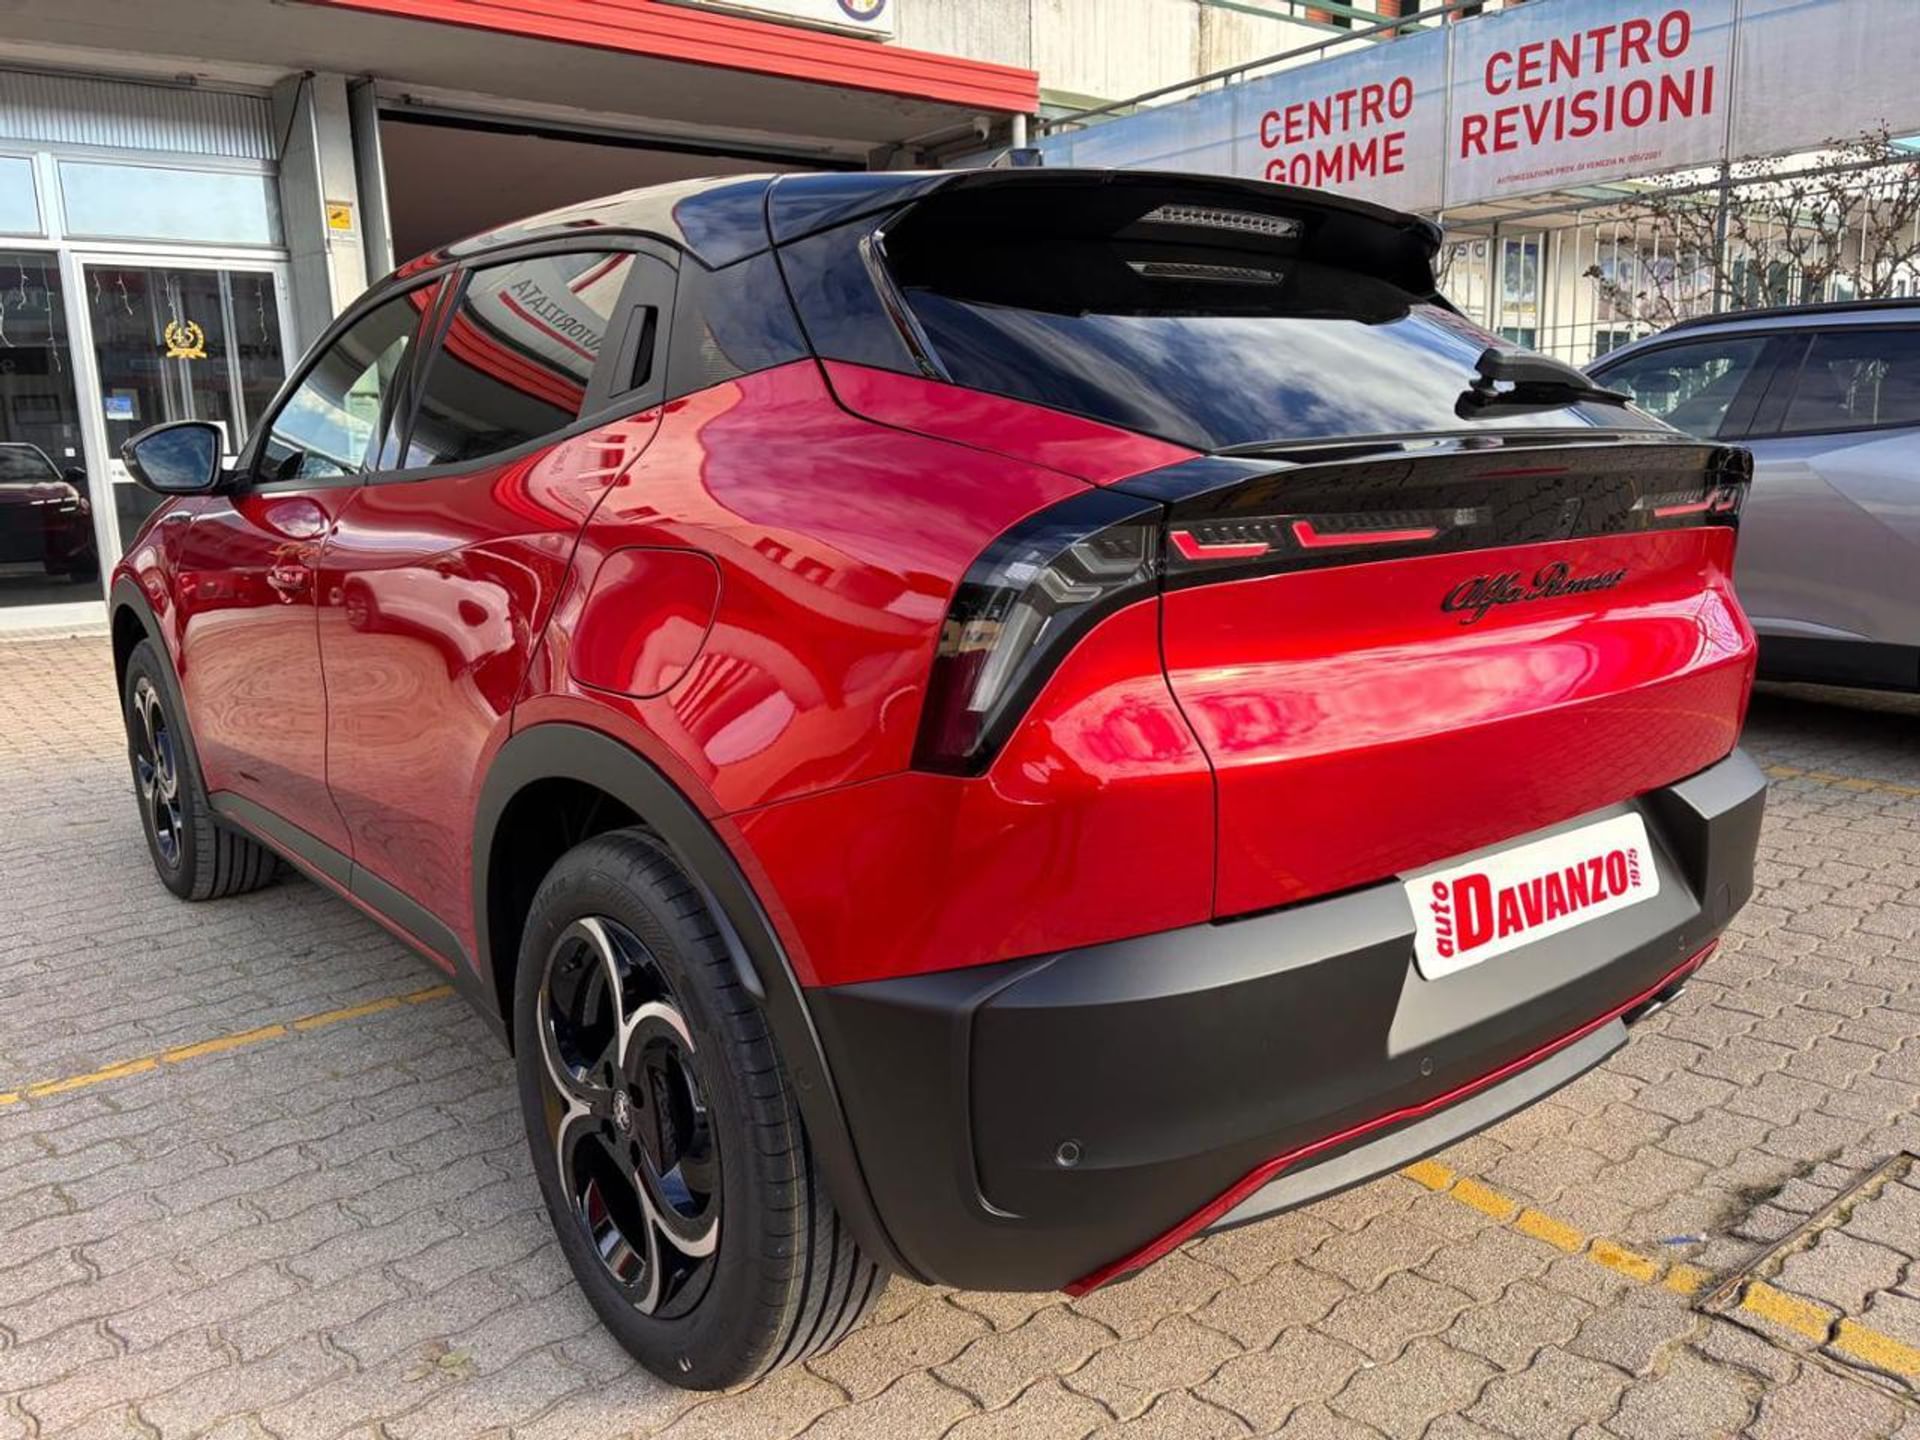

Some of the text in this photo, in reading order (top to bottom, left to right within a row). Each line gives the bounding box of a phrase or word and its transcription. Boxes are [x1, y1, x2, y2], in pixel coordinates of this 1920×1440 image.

[1485, 10, 1692, 96] CENTRO
[1260, 75, 1413, 149] CENTRO
[1461, 65, 1715, 159] REVISIONI
[1265, 131, 1405, 187] GOMME
[1440, 561, 1627, 625] Alfa Romeo
[1429, 881, 1453, 958] auto
[1451, 849, 1629, 952] DAVANZO
